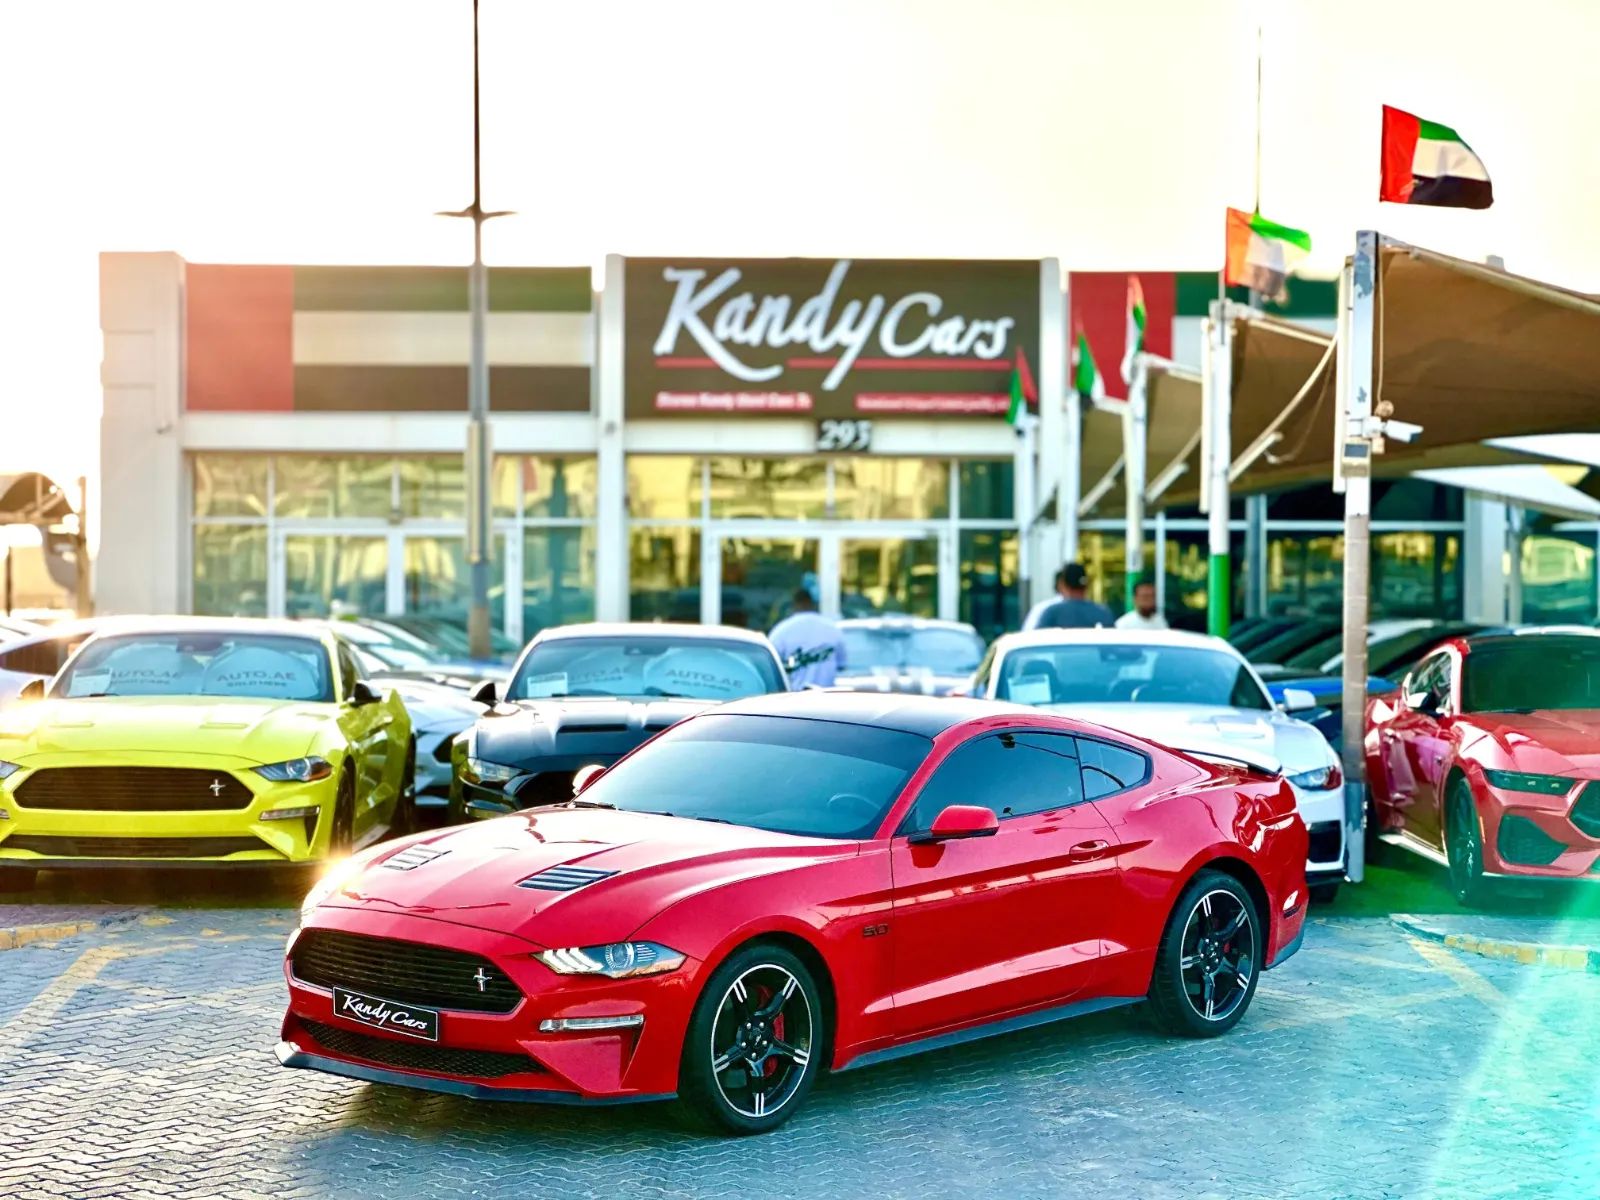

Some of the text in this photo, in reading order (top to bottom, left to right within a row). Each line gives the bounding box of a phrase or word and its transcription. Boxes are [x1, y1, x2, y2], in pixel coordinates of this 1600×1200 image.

[653, 259, 1014, 391] Kandy Cars
[216, 669, 297, 682] AUTO.AE
[342, 994, 428, 1029] Kandy Cars
